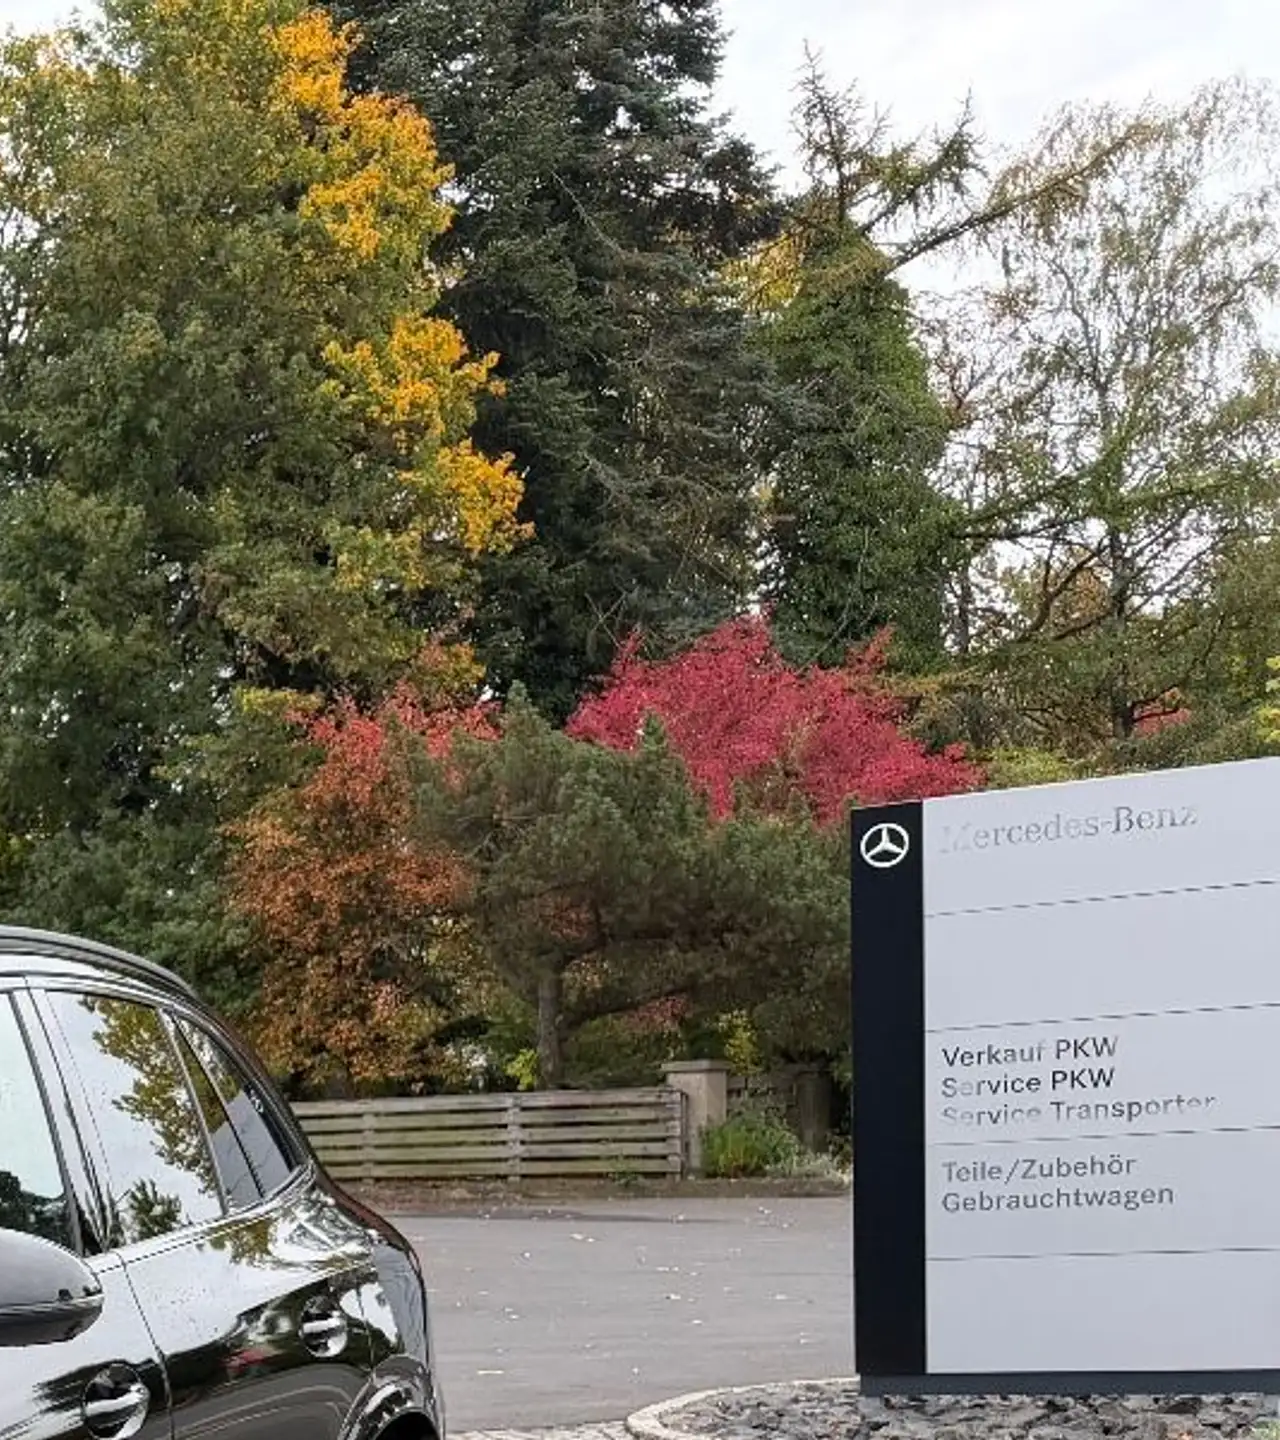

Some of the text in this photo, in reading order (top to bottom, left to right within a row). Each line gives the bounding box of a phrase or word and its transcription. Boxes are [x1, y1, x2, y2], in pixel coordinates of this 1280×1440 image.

[939, 805, 1198, 854] Mercedes-Benz
[942, 1036, 1119, 1067] Verkauf PKW
[942, 1067, 1115, 1098] Service PKW
[942, 1094, 1216, 1125] Service Transporter
[942, 1154, 1137, 1185] Teile/Zubehör
[942, 1187, 1175, 1213] Gebrauchtwagen
